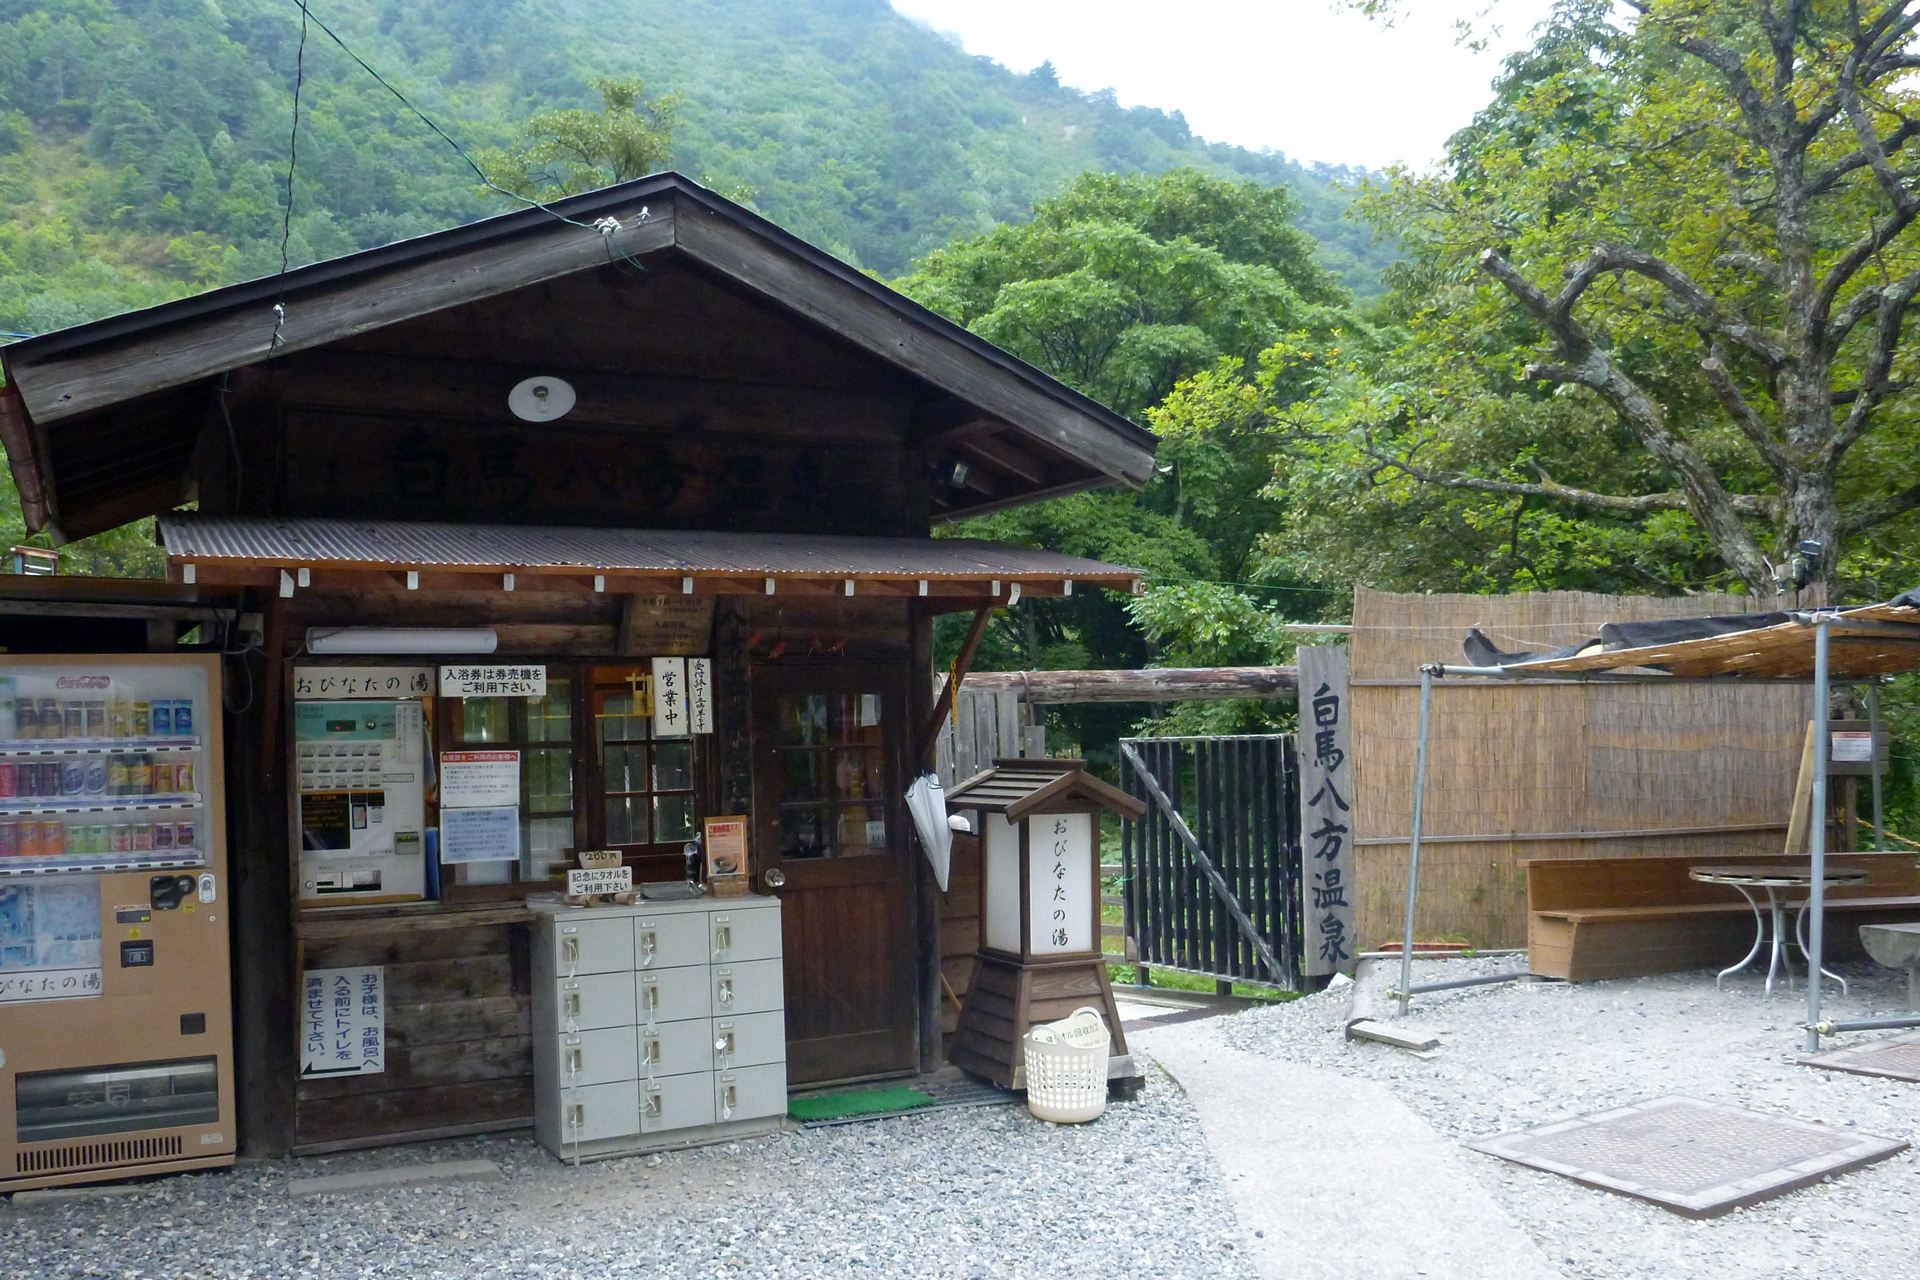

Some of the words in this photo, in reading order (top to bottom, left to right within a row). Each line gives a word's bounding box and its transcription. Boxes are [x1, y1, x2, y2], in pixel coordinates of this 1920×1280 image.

[296, 672, 429, 693] おびなたの湯
[445, 668, 542, 680] 入浴券は券売機を
[462, 681, 538, 694] ご利用下さい。
[662, 672, 678, 726] 営業中
[1308, 683, 1350, 964] 白馬八方温泉
[572, 869, 629, 882] 記念にタオルを
[576, 882, 628, 894] ご利用下さい
[1052, 819, 1069, 946] おびなたの湯
[306, 977, 325, 1057] 済ませて下さい。
[334, 975, 352, 1060] 入る前にトイレを
[361, 973, 380, 1066] お子様は、お風呂へ
